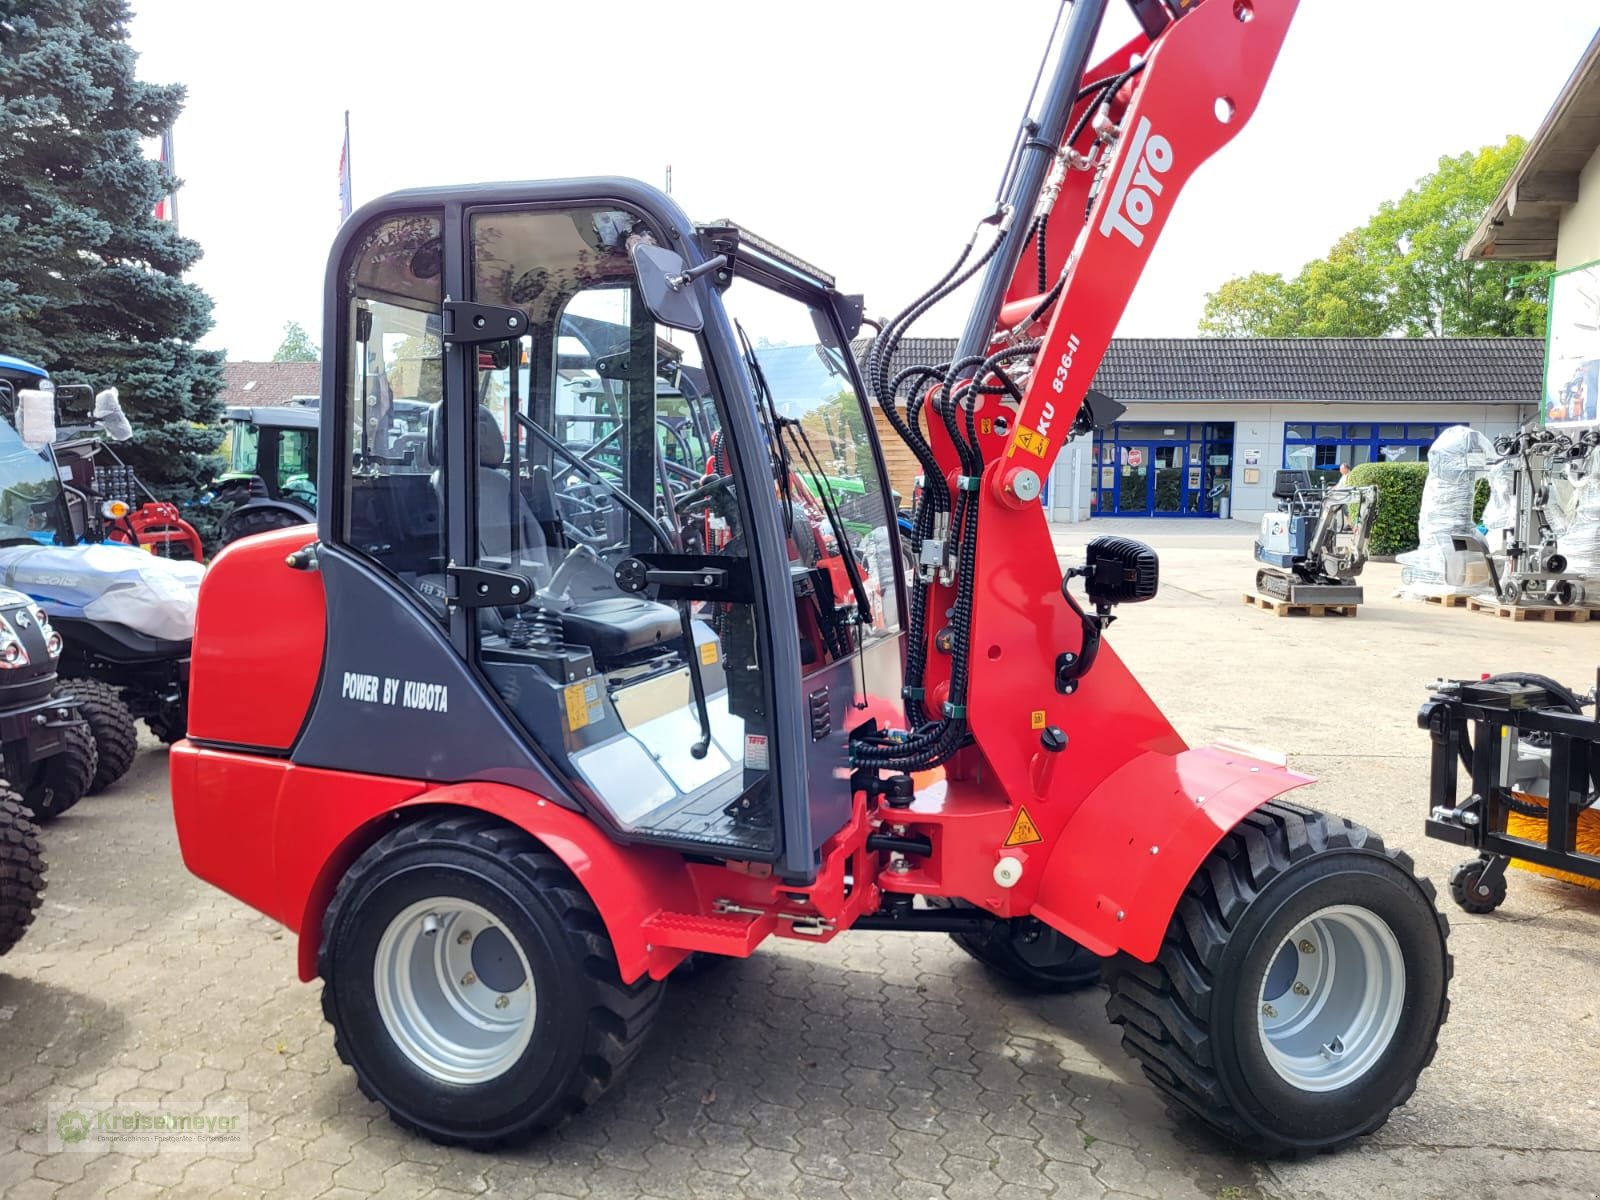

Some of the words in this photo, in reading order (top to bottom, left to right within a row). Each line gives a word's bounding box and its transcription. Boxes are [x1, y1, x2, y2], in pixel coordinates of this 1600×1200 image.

[1099, 115, 1173, 248] TOYO
[1036, 401, 1055, 436] KU
[342, 671, 379, 703] POWER
[383, 677, 400, 706] BY
[403, 680, 448, 713] KUBOTA
